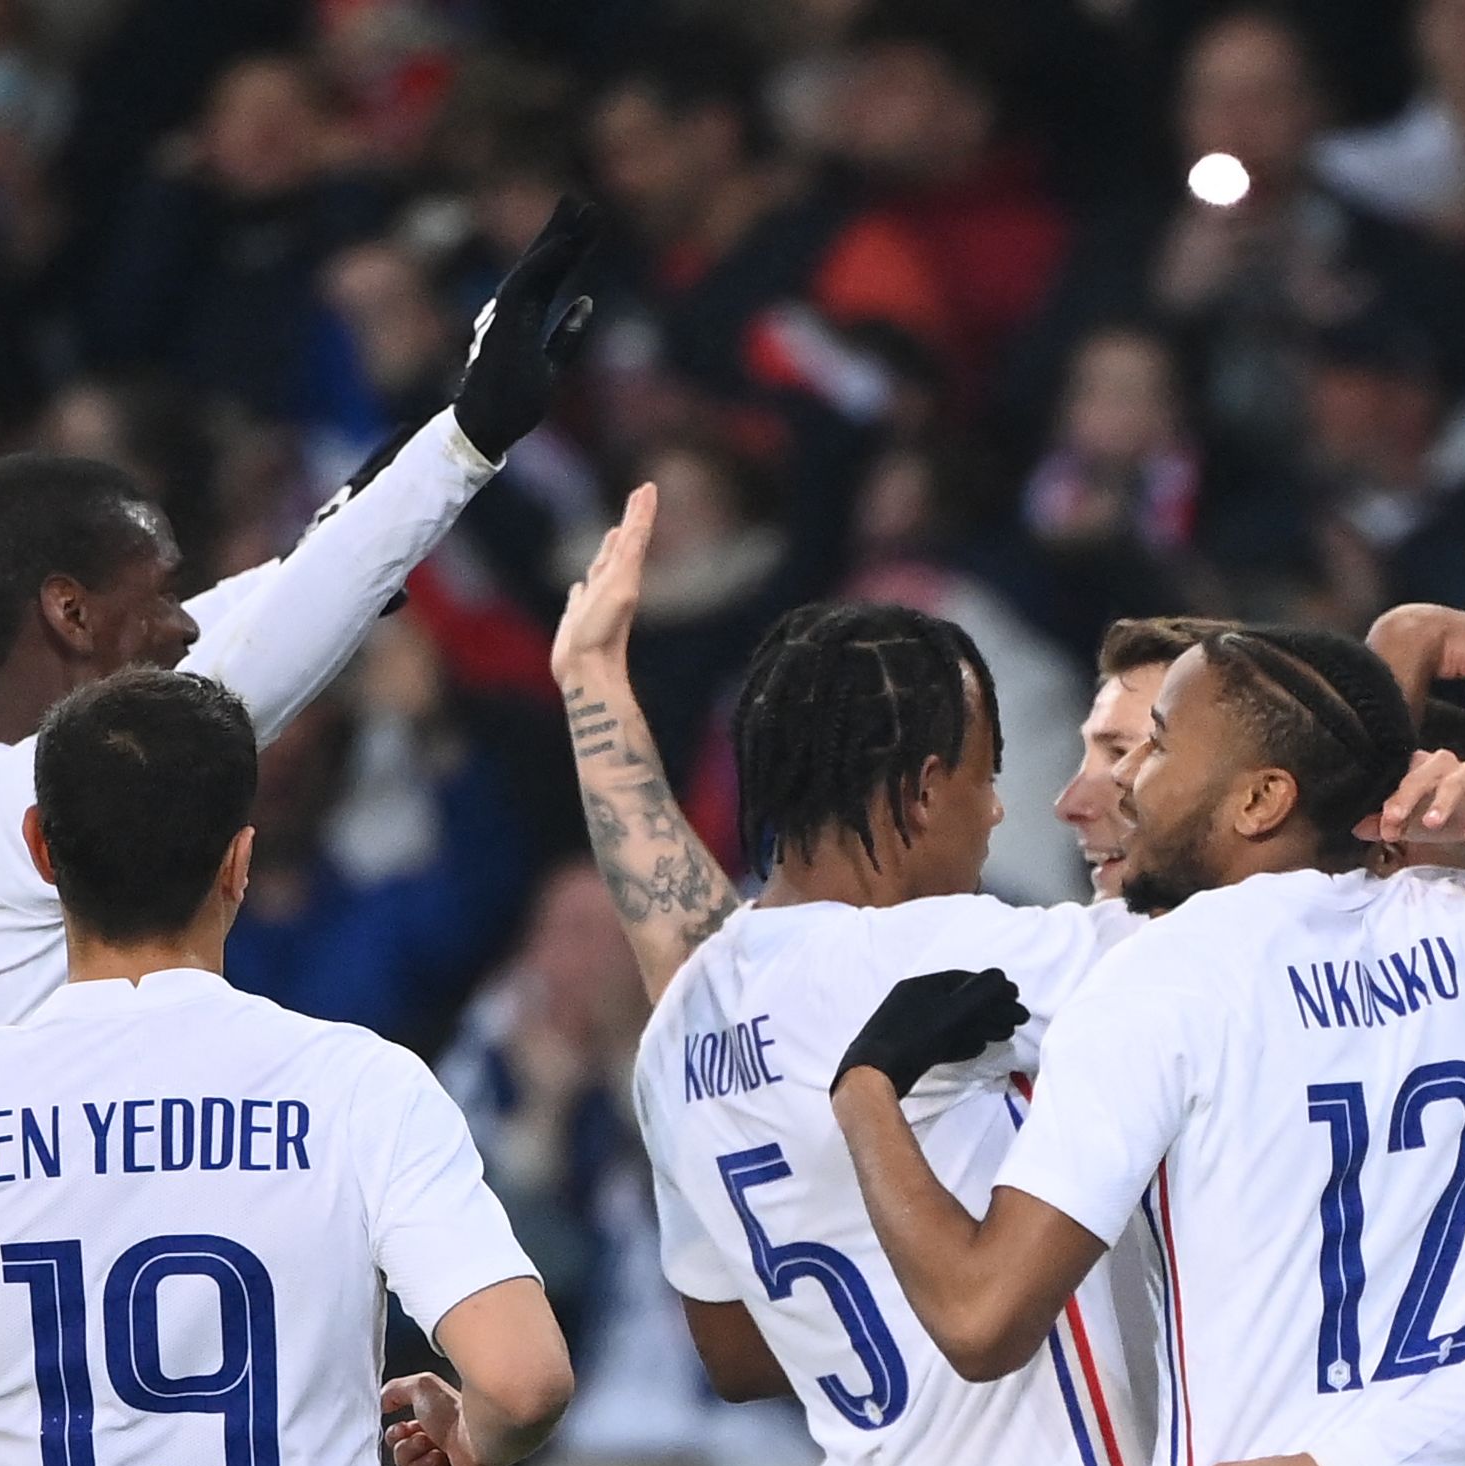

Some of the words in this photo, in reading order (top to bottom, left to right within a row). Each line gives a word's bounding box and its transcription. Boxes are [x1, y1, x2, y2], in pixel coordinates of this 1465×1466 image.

[1287, 936, 1459, 1030] NKUNKU
[684, 1013, 784, 1105] KOUNDE
[83, 1096, 311, 1175] YEDDER
[716, 1142, 909, 1432] 5
